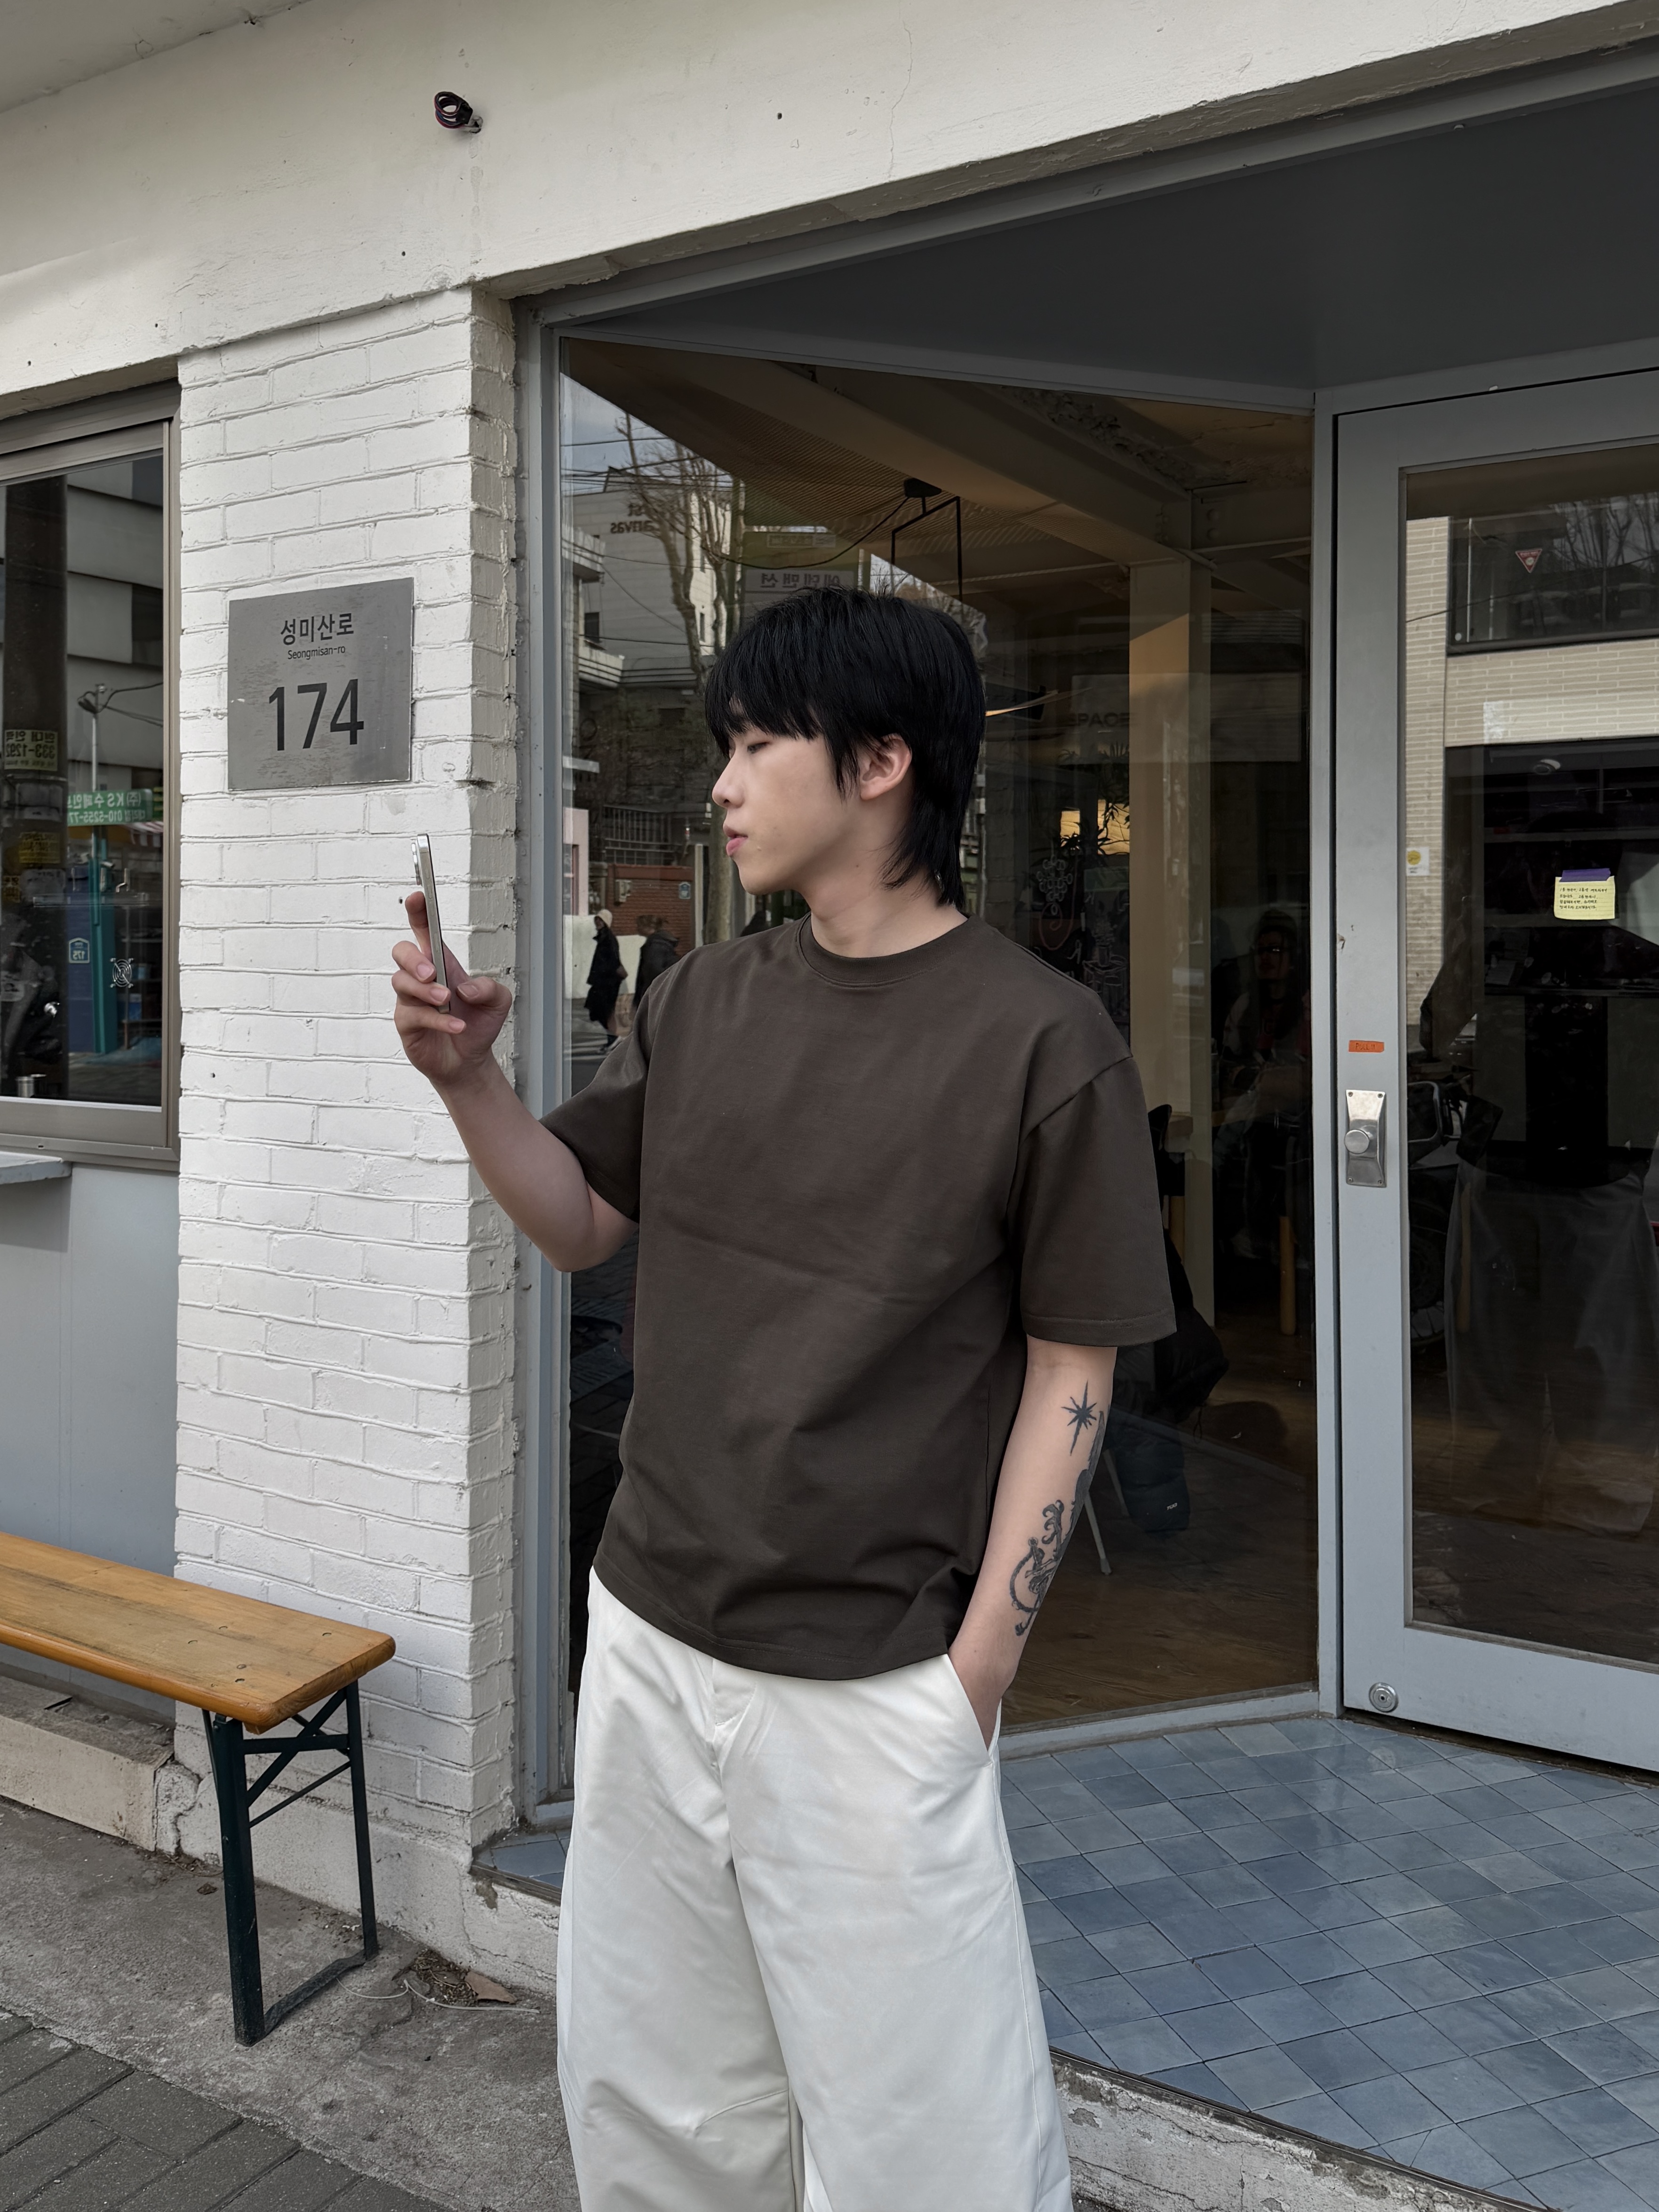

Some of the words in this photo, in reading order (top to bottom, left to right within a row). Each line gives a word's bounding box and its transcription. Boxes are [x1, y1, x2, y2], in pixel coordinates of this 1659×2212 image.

[280, 613, 354, 645] 성미산로
[287, 645, 346, 660] Seongmisan-ro
[269, 678, 364, 751] 174
